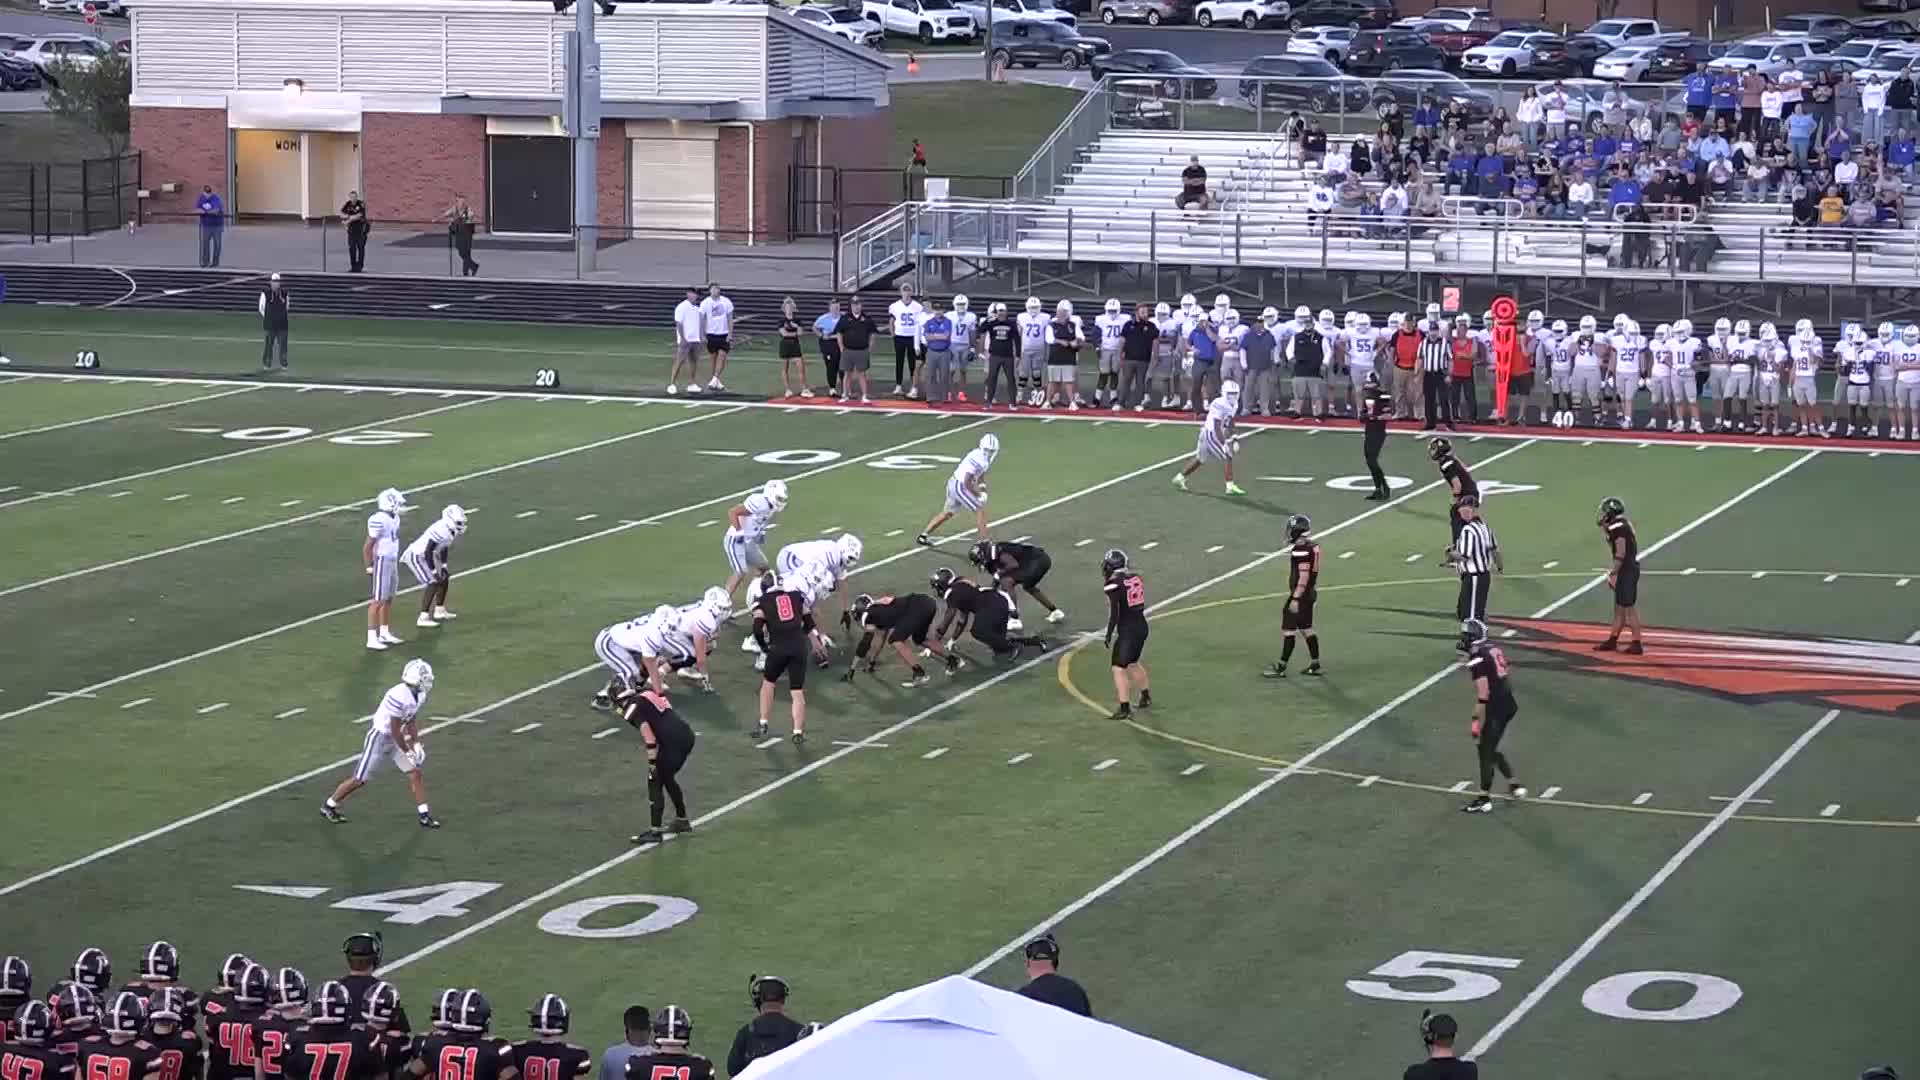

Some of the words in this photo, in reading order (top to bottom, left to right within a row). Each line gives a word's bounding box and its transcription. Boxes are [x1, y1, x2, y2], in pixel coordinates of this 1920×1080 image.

[1025, 323, 1041, 338] 73
[75, 351, 95, 368] 10
[535, 369, 555, 386] 20
[1028, 389, 1045, 405] 30
[1552, 410, 1574, 428] 40
[776, 594, 795, 621] 8
[262, 1030, 287, 1074] 2
[305, 1042, 352, 1080] 77
[439, 1045, 479, 1080] 61
